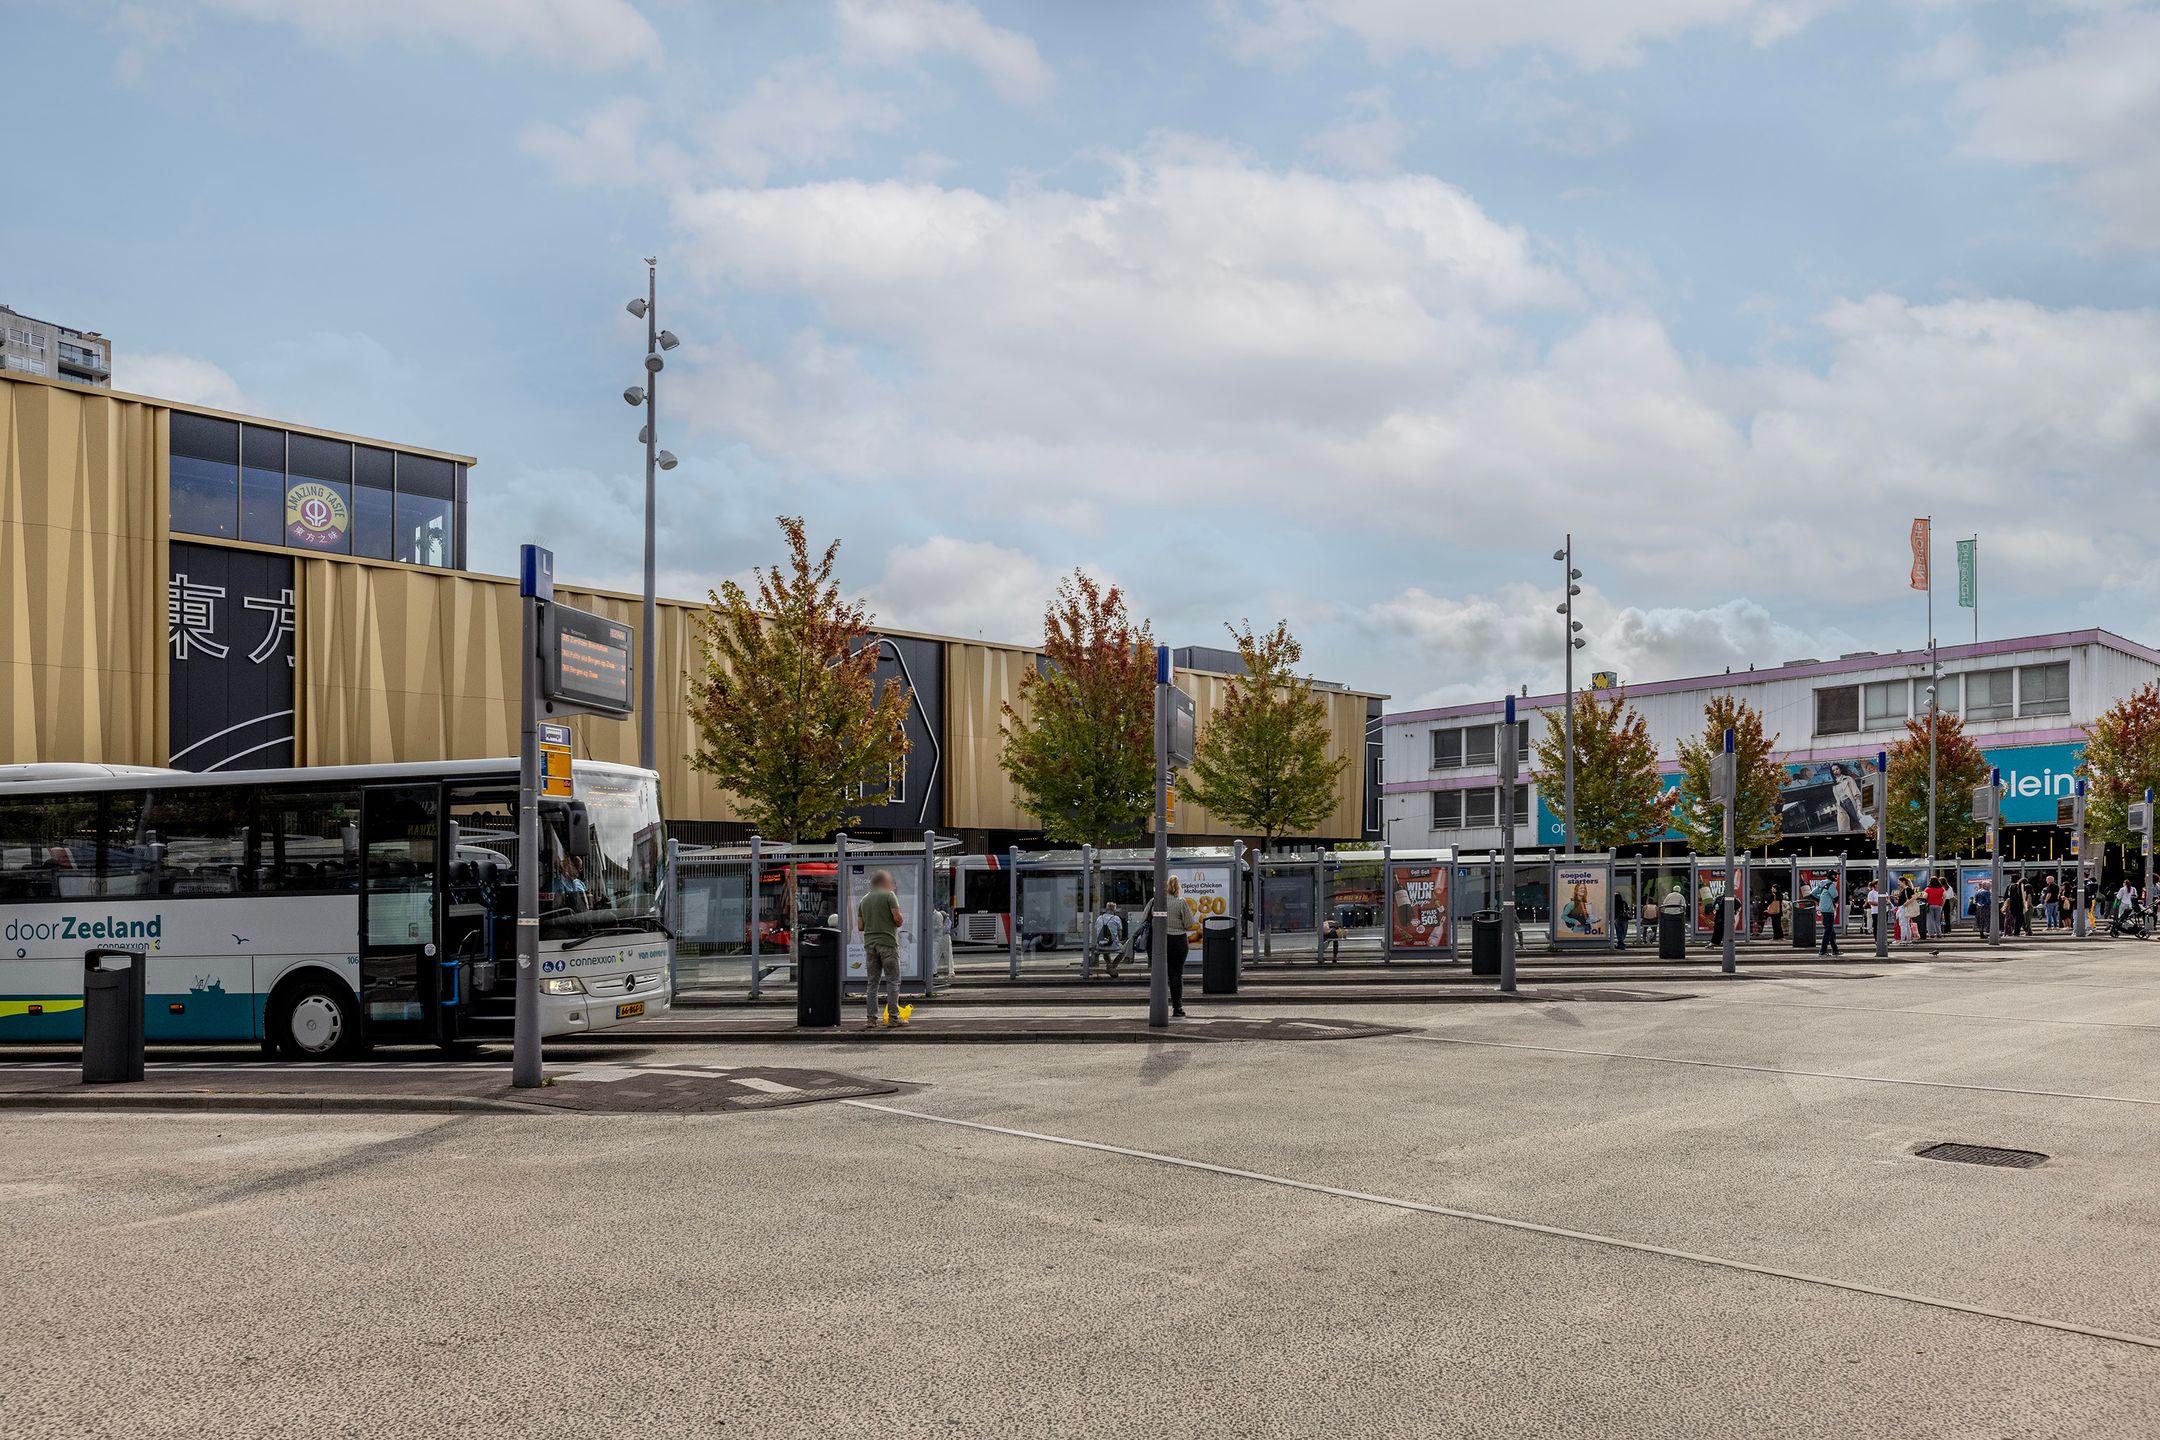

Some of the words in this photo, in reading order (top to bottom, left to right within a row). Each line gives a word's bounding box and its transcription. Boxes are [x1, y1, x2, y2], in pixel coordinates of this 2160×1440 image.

[288, 486, 324, 512] AMAZING
[326, 491, 345, 518] TASTE
[542, 553, 551, 576] L
[1560, 871, 1592, 880] soepele
[1406, 882, 1434, 891] WILDE
[1409, 890, 1432, 900] WIJN
[569, 953, 616, 968] connexxion
